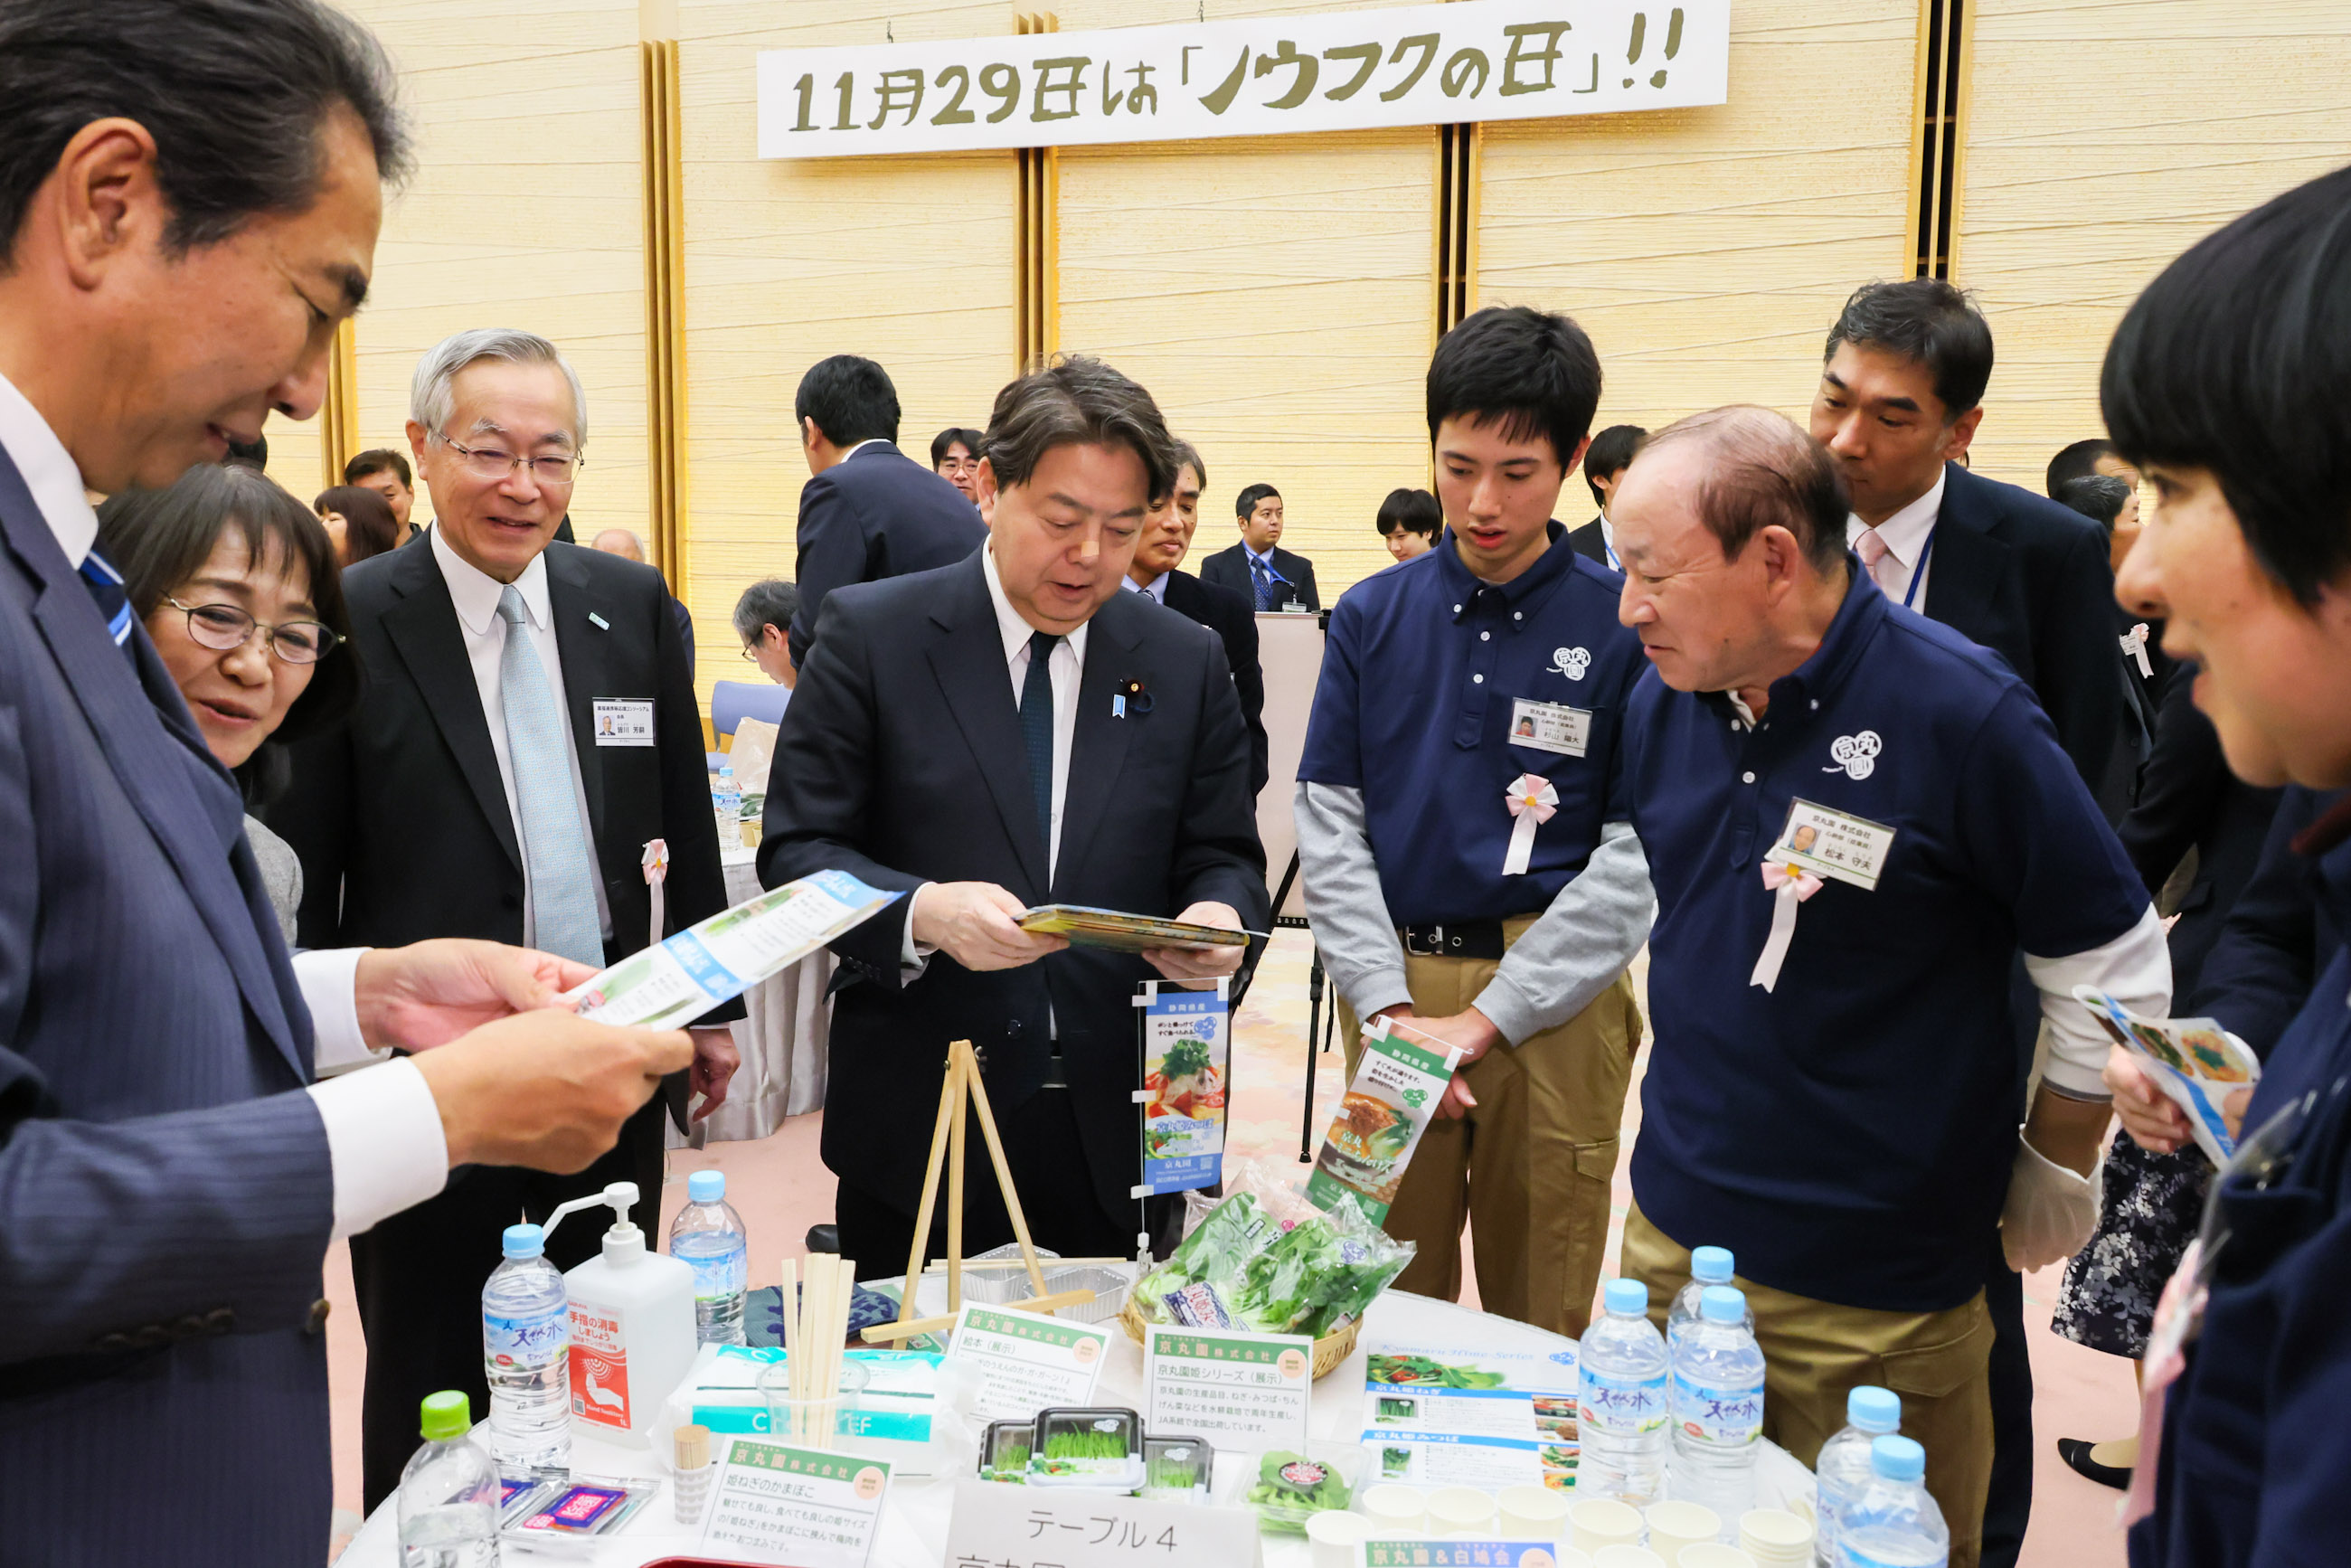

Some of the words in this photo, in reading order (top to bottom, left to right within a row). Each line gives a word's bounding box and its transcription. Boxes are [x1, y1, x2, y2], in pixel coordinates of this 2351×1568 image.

[511, 1321, 563, 1347] 天然水
[570, 1310, 619, 1334] 手指の消毒
[578, 1326, 610, 1342] しましょう
[1159, 1340, 1270, 1363] 京丸園株式会社
[1594, 1386, 1652, 1412] 天然水
[1704, 1399, 1759, 1422] 天然水
[733, 1448, 849, 1479] 京丸園株式会社
[725, 1474, 816, 1499] 姫ねぎのかまぼこ
